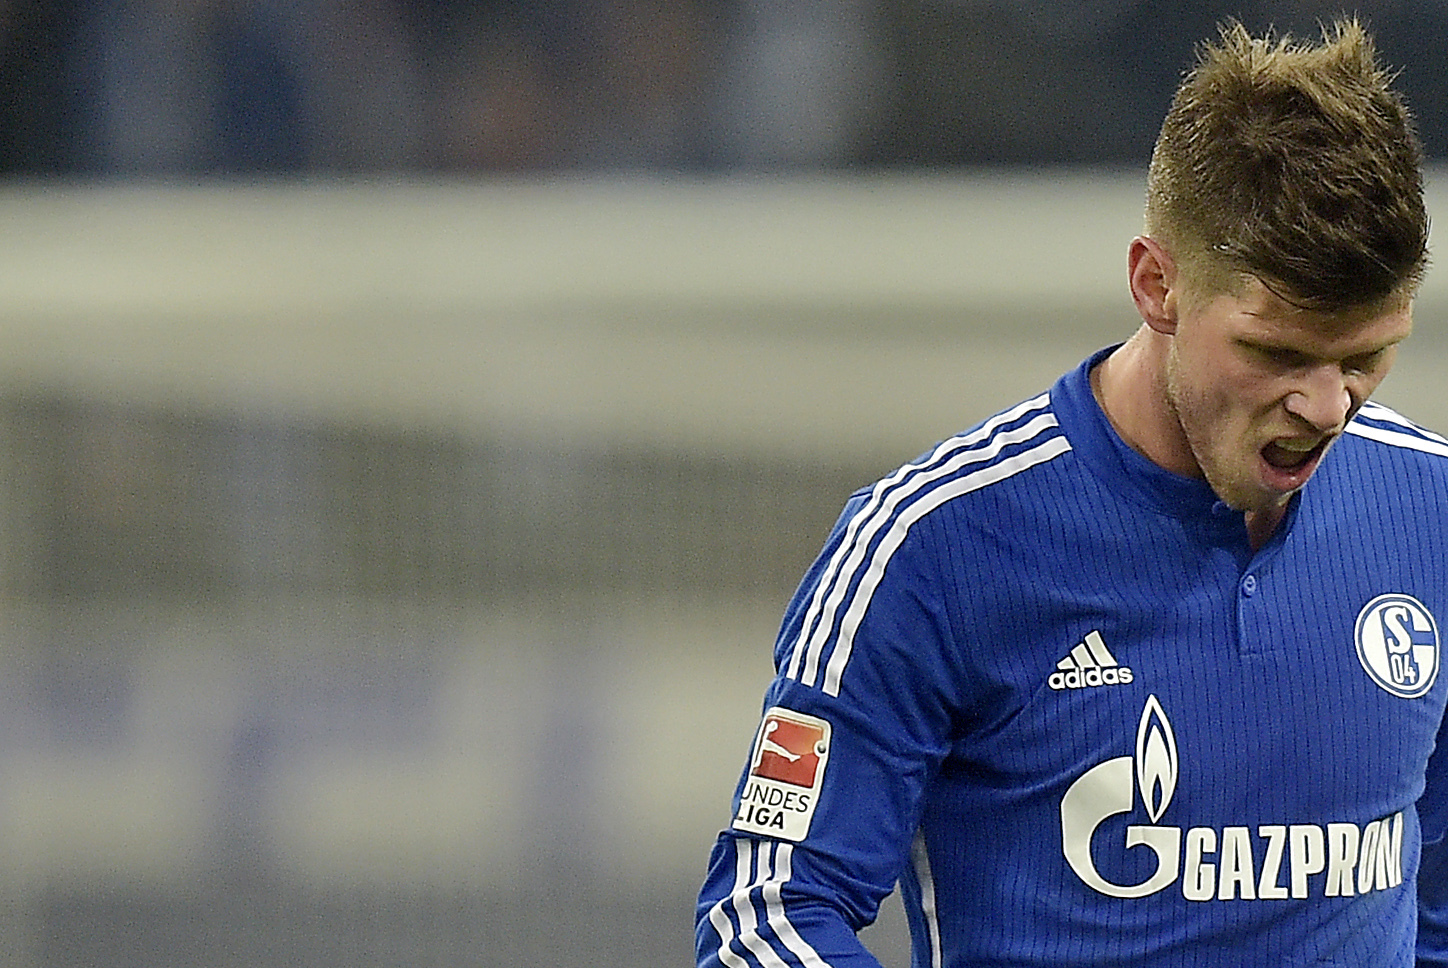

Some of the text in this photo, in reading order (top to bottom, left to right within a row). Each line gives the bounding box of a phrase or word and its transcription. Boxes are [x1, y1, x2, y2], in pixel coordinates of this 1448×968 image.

[1048, 666, 1133, 690] adidas
[743, 783, 810, 813] UNDES
[1182, 812, 1402, 901] GAZPROM
